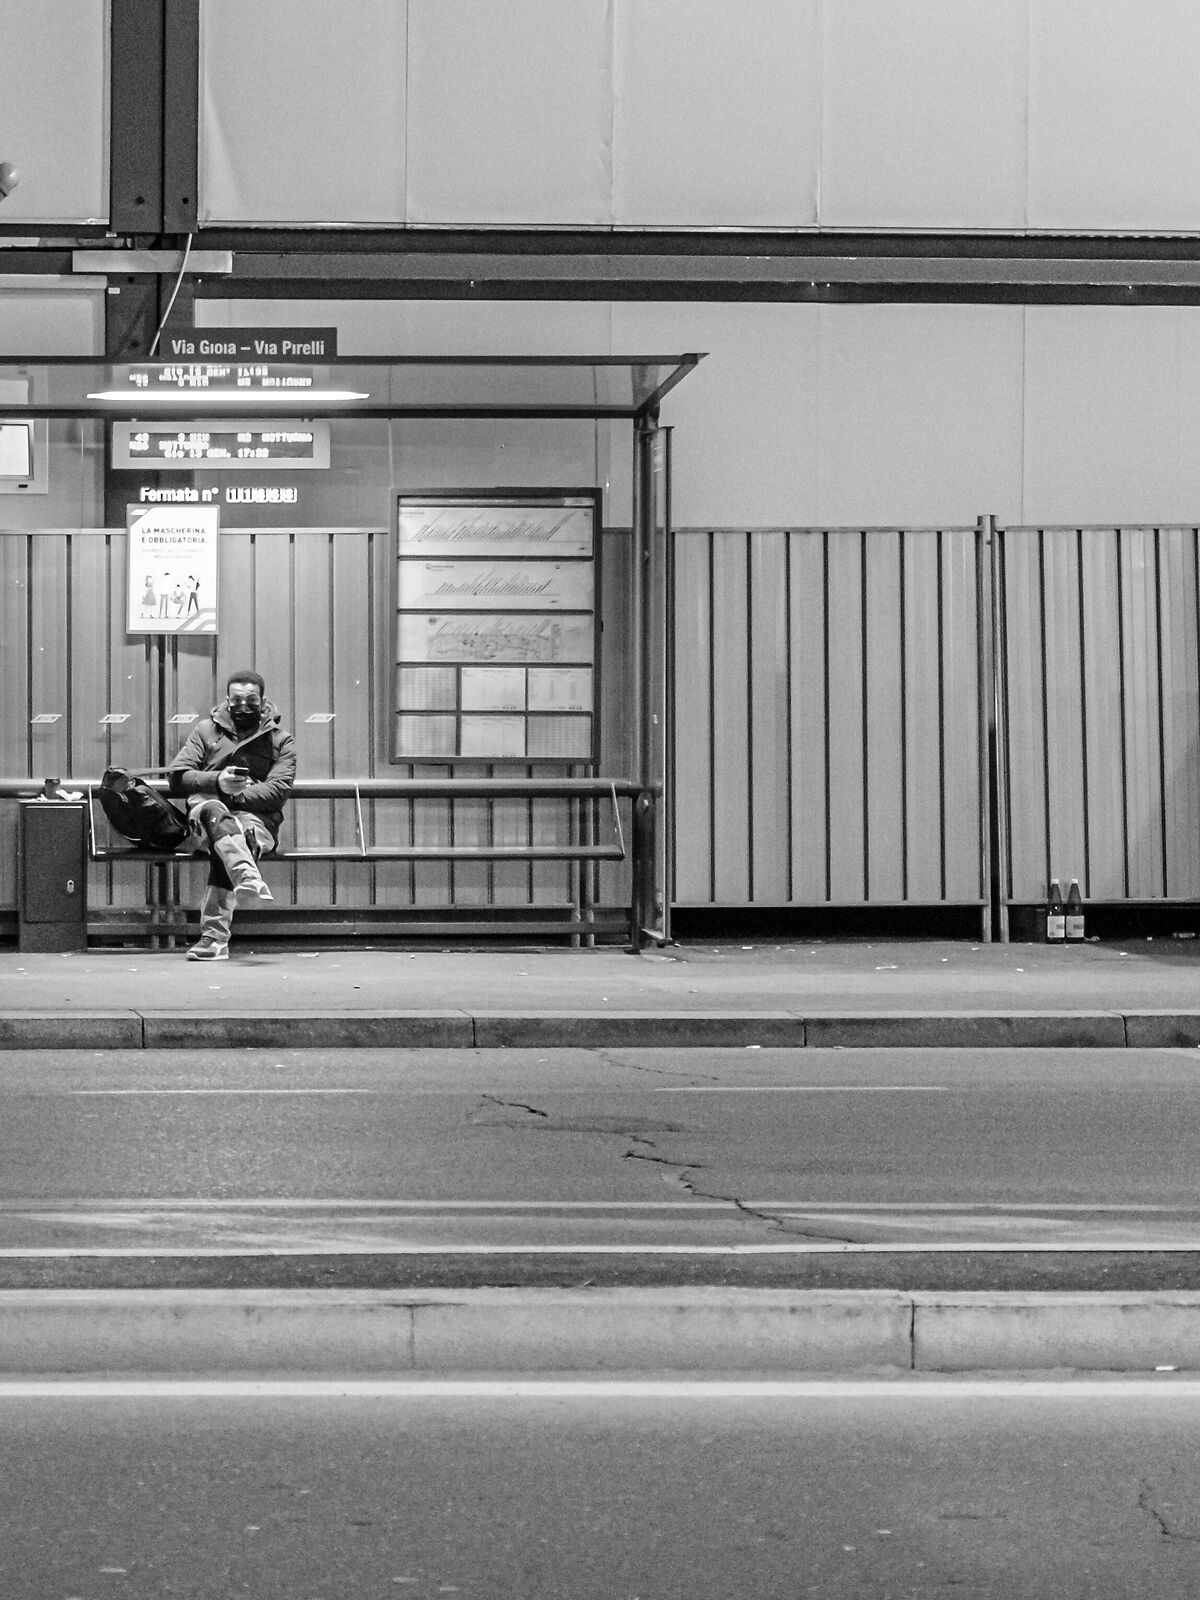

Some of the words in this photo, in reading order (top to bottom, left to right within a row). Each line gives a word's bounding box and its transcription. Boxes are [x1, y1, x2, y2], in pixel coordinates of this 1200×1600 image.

[171, 339, 195, 355] Via
[199, 339, 237, 355] Gioia
[254, 339, 278, 355] Via
[282, 340, 325, 356] Pirelli
[139, 487, 199, 502] Fermata
[141, 527, 152, 535] LA
[153, 527, 206, 535] MASCHERINA
[148, 536, 206, 544] OBBLIGATORIA
